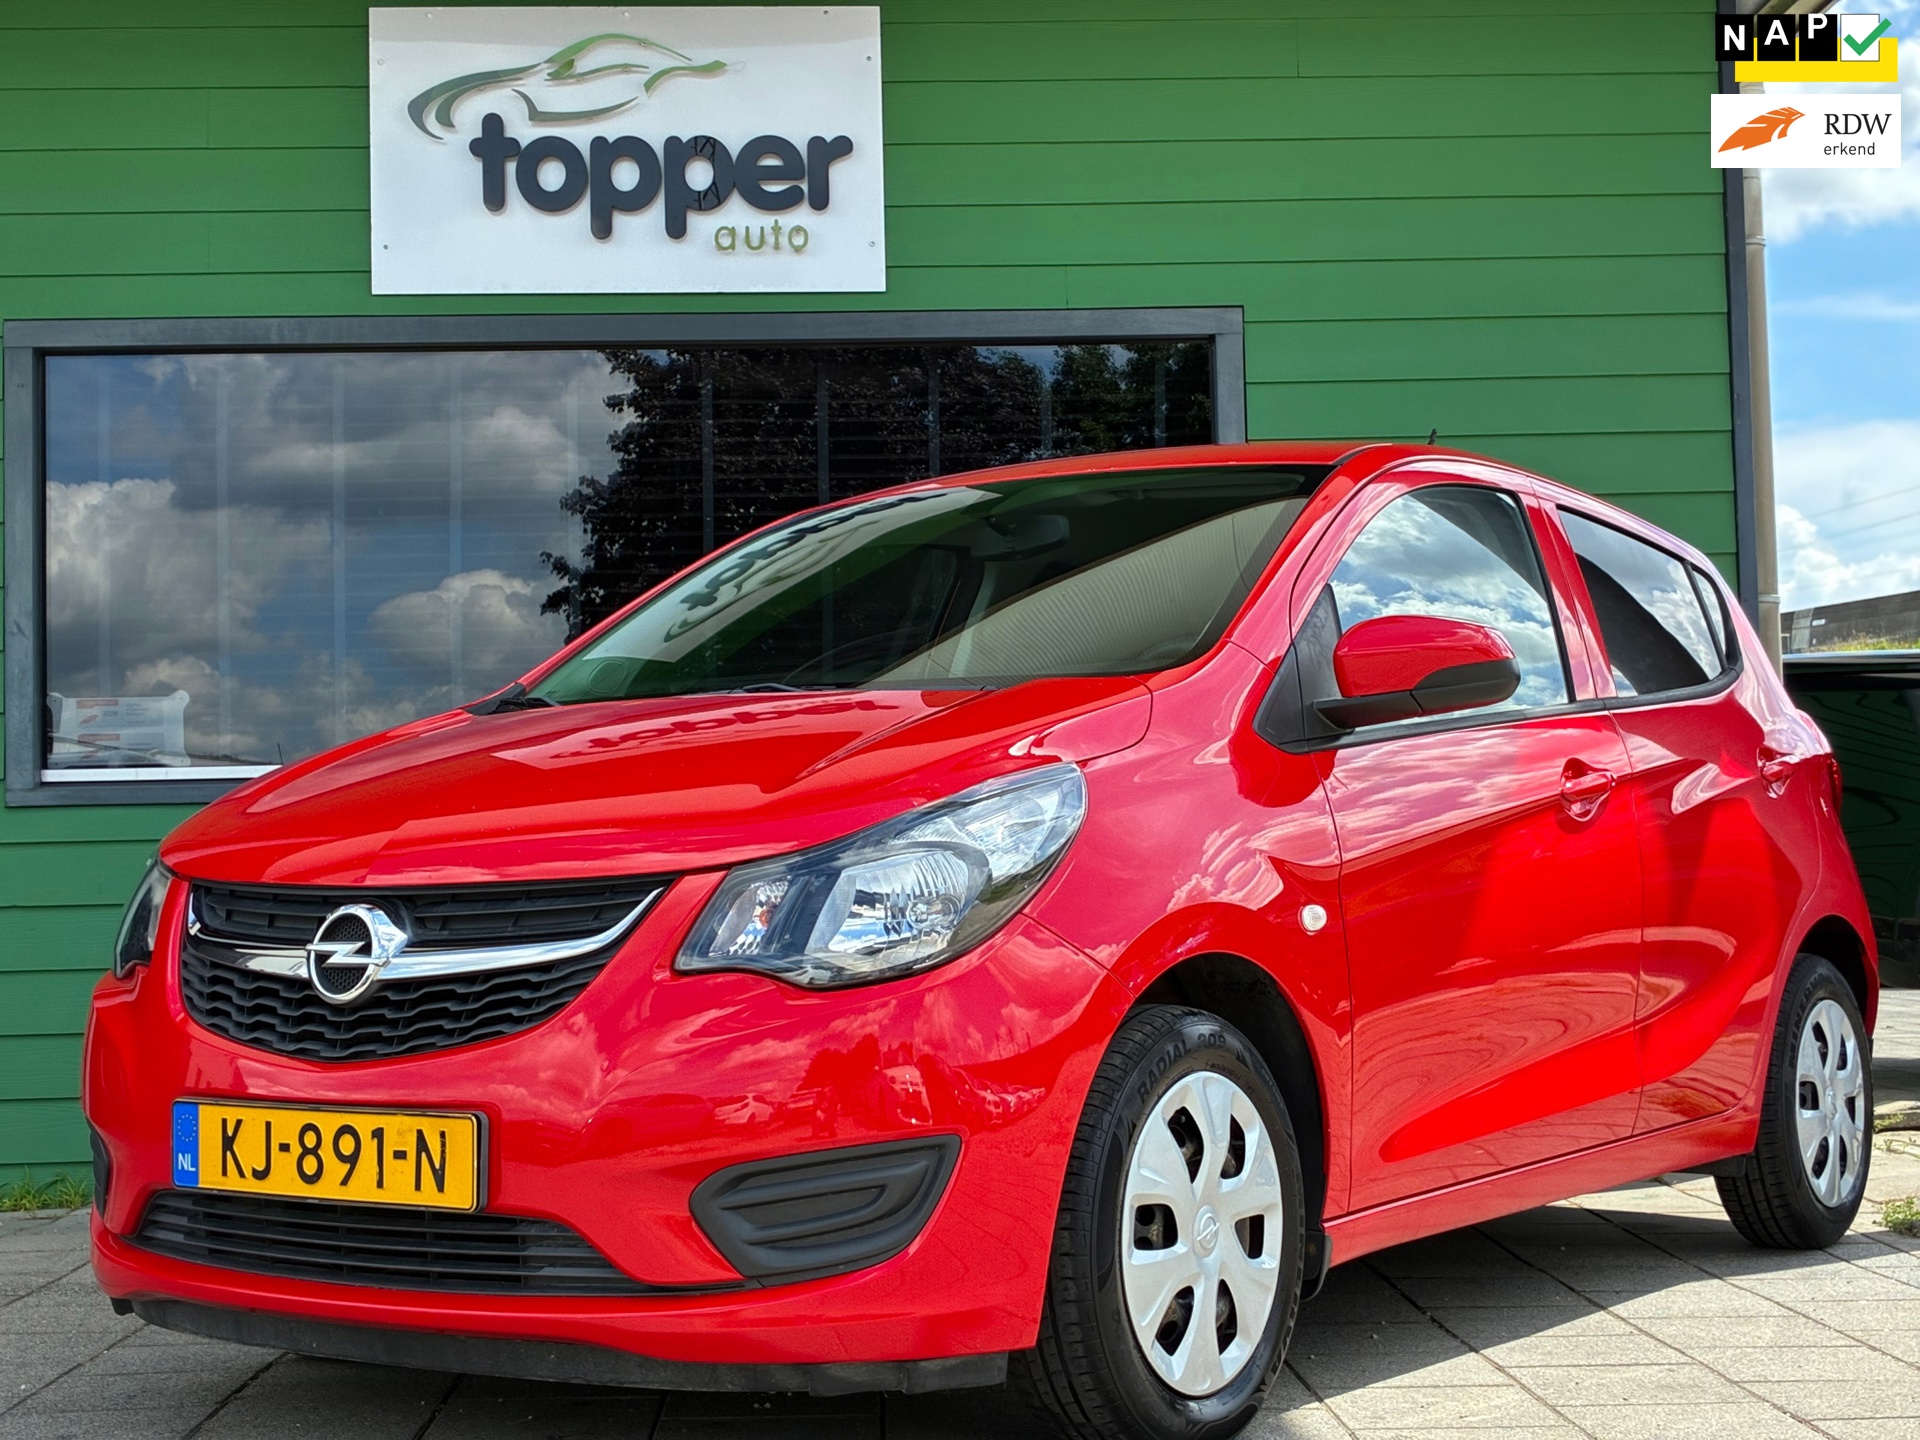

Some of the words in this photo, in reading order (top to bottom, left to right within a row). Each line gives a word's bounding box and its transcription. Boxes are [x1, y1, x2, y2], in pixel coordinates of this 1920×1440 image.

[469, 112, 853, 240] topper
[714, 219, 809, 252] auto
[1137, 1038, 1191, 1104] RADIAL
[1197, 1033, 1226, 1048] 209
[178, 1153, 196, 1171] NL
[221, 1117, 446, 1193] KJ-891-N
